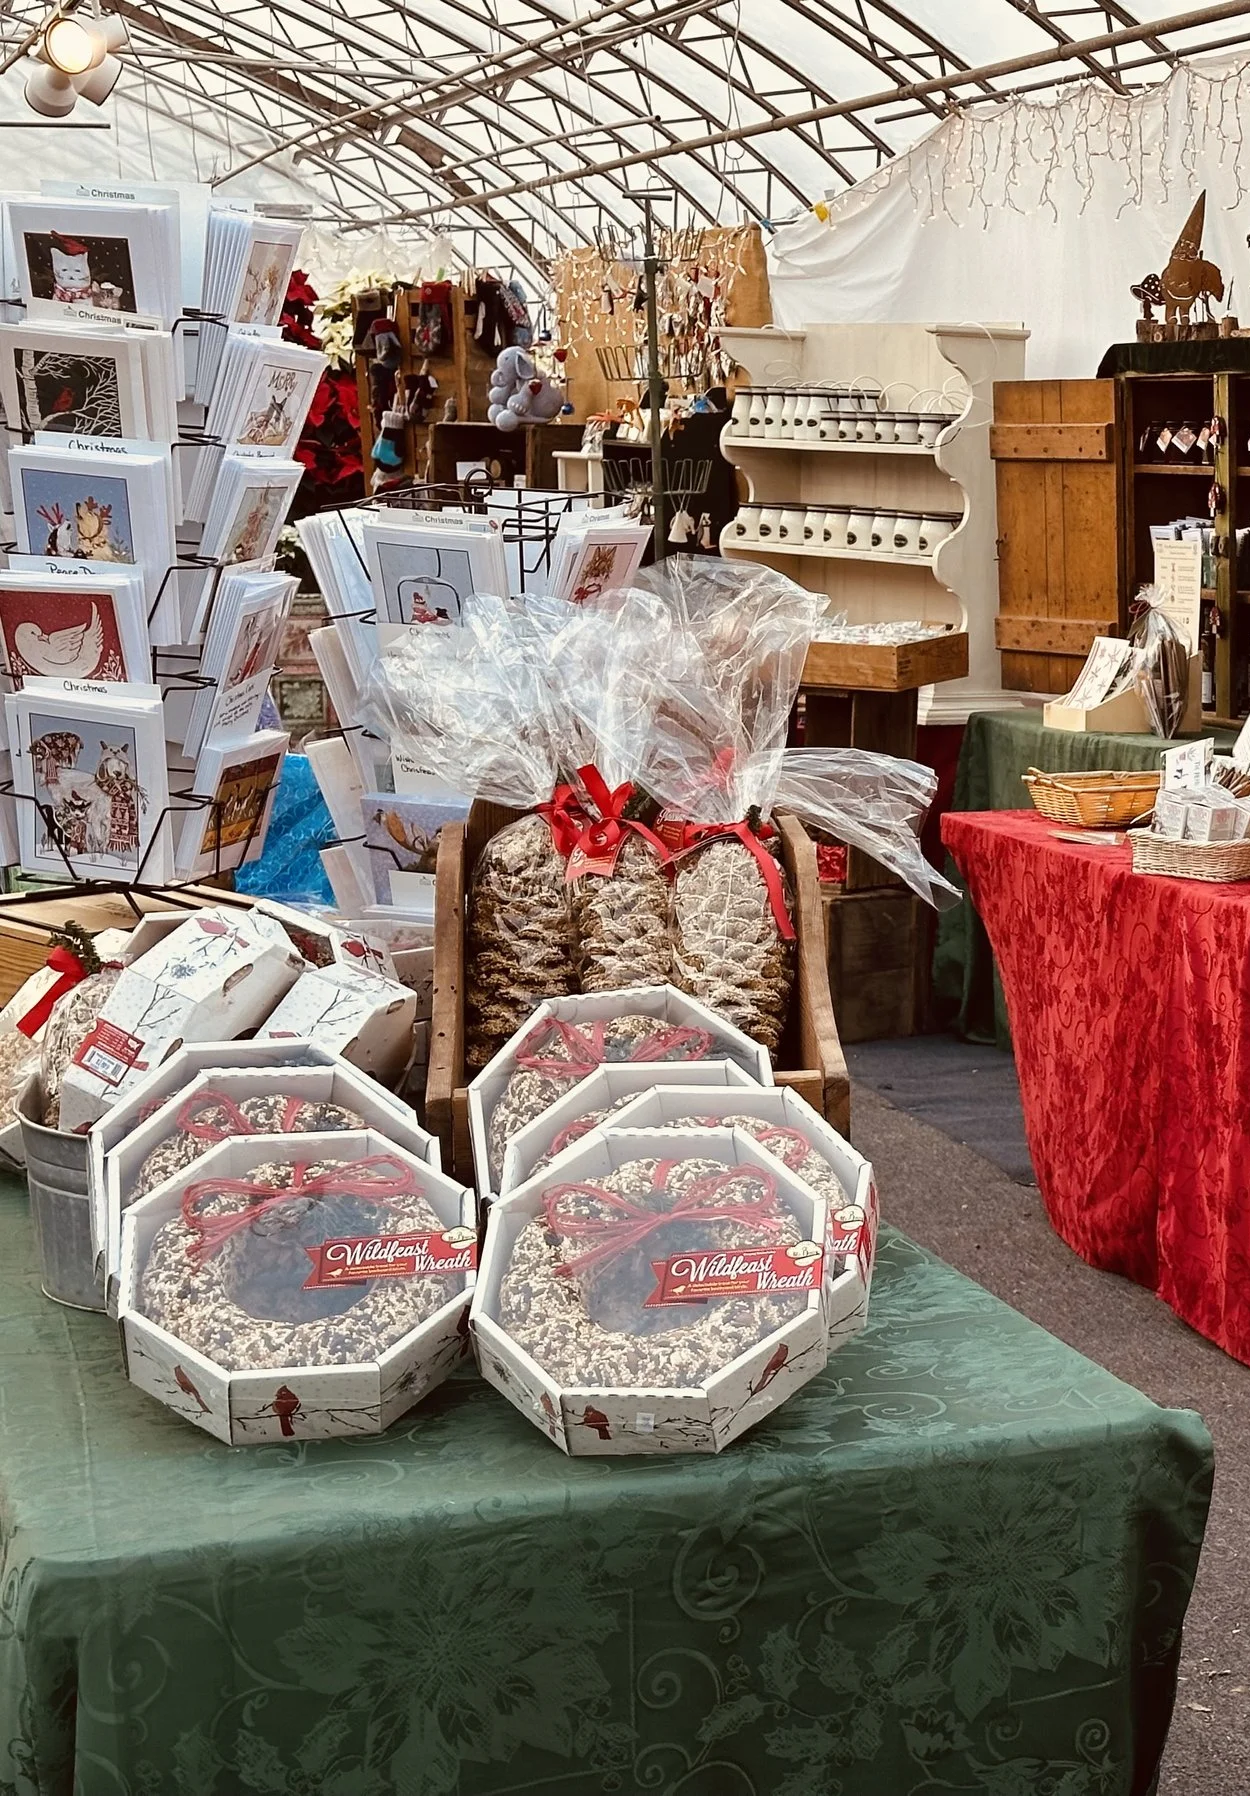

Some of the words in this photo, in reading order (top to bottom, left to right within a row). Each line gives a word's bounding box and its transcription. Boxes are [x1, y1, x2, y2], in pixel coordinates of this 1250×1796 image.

[91, 189, 135, 200] Christmas
[78, 310, 122, 324] Christmas
[68, 439, 128, 454] Christmas
[425, 515, 463, 525] Christmas
[63, 680, 108, 694] Christmas
[326, 1237, 429, 1266] Wildfeast
[415, 1249, 472, 1272] Wreath
[671, 1253, 773, 1282] Wildfeast
[756, 1266, 815, 1290] Wreath
